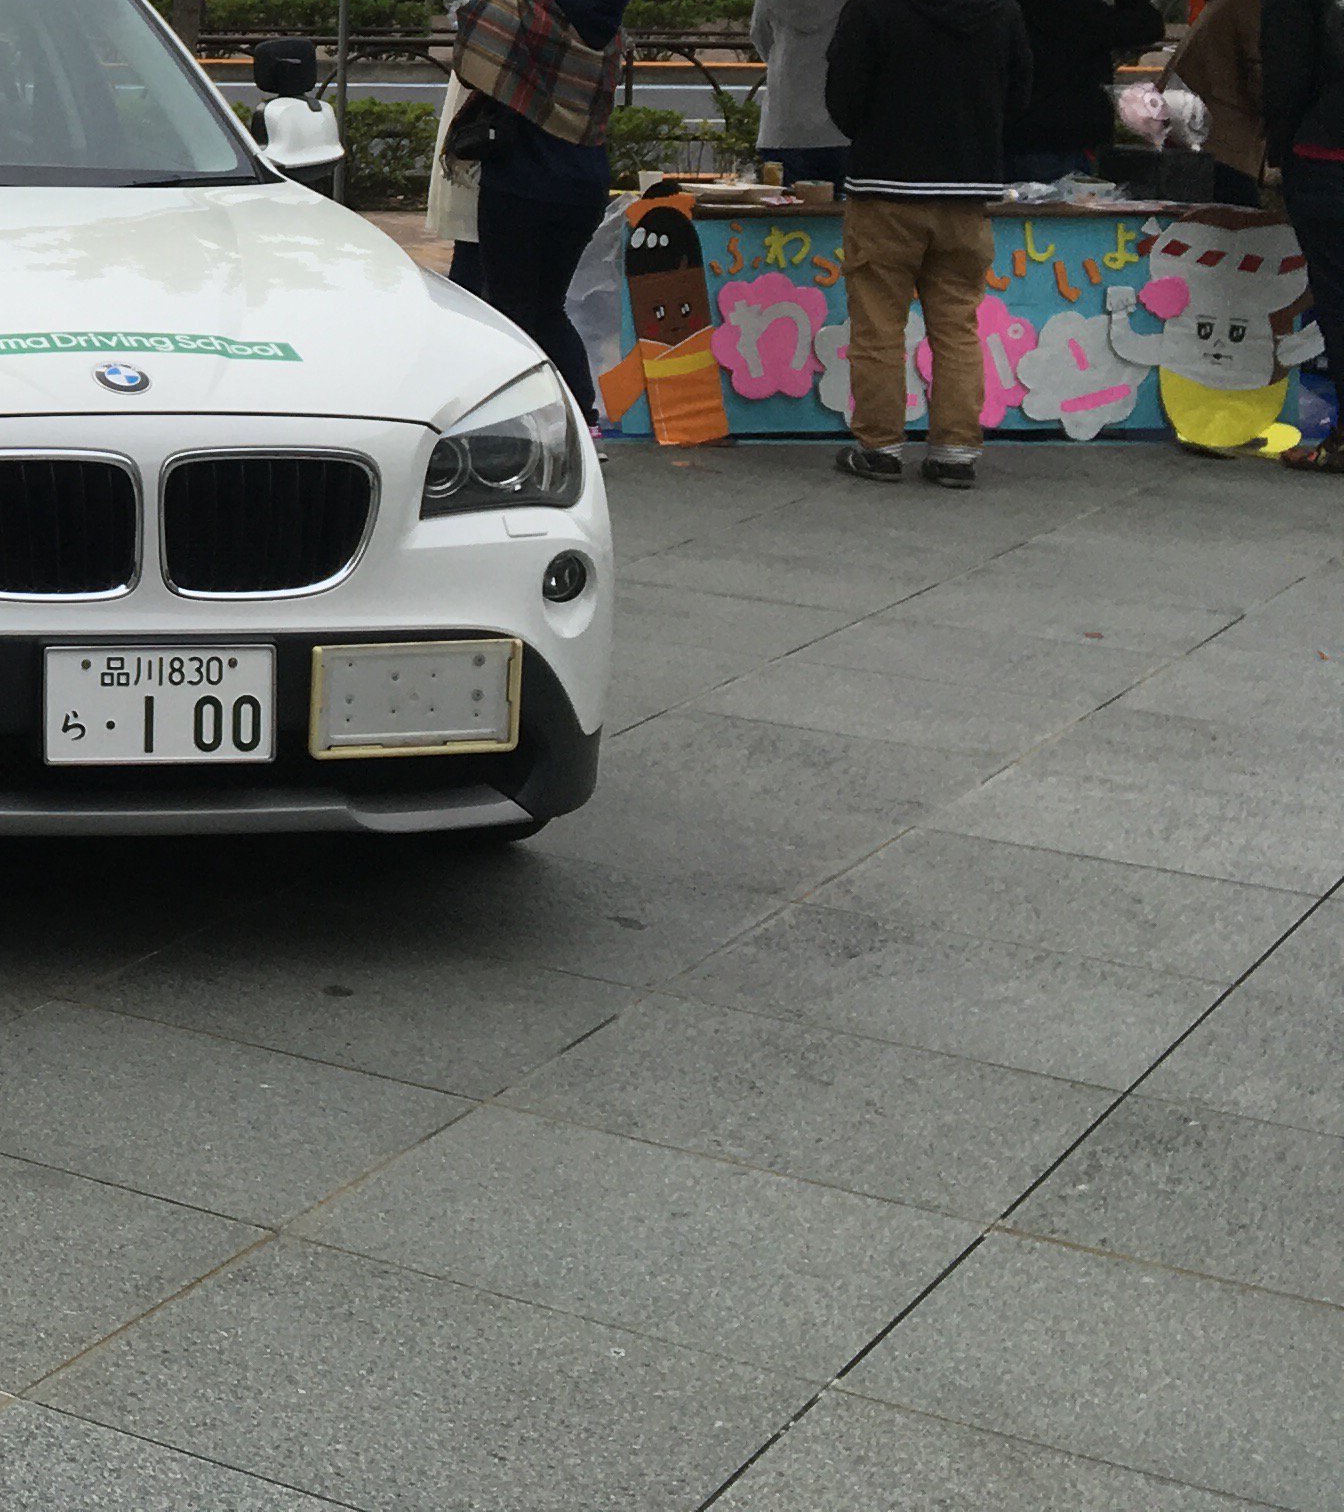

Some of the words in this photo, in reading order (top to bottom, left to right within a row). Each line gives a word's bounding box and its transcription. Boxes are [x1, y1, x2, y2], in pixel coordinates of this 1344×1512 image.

[51, 332, 176, 353] Driving
[178, 333, 282, 357] School
[100, 655, 225, 688] 品川830
